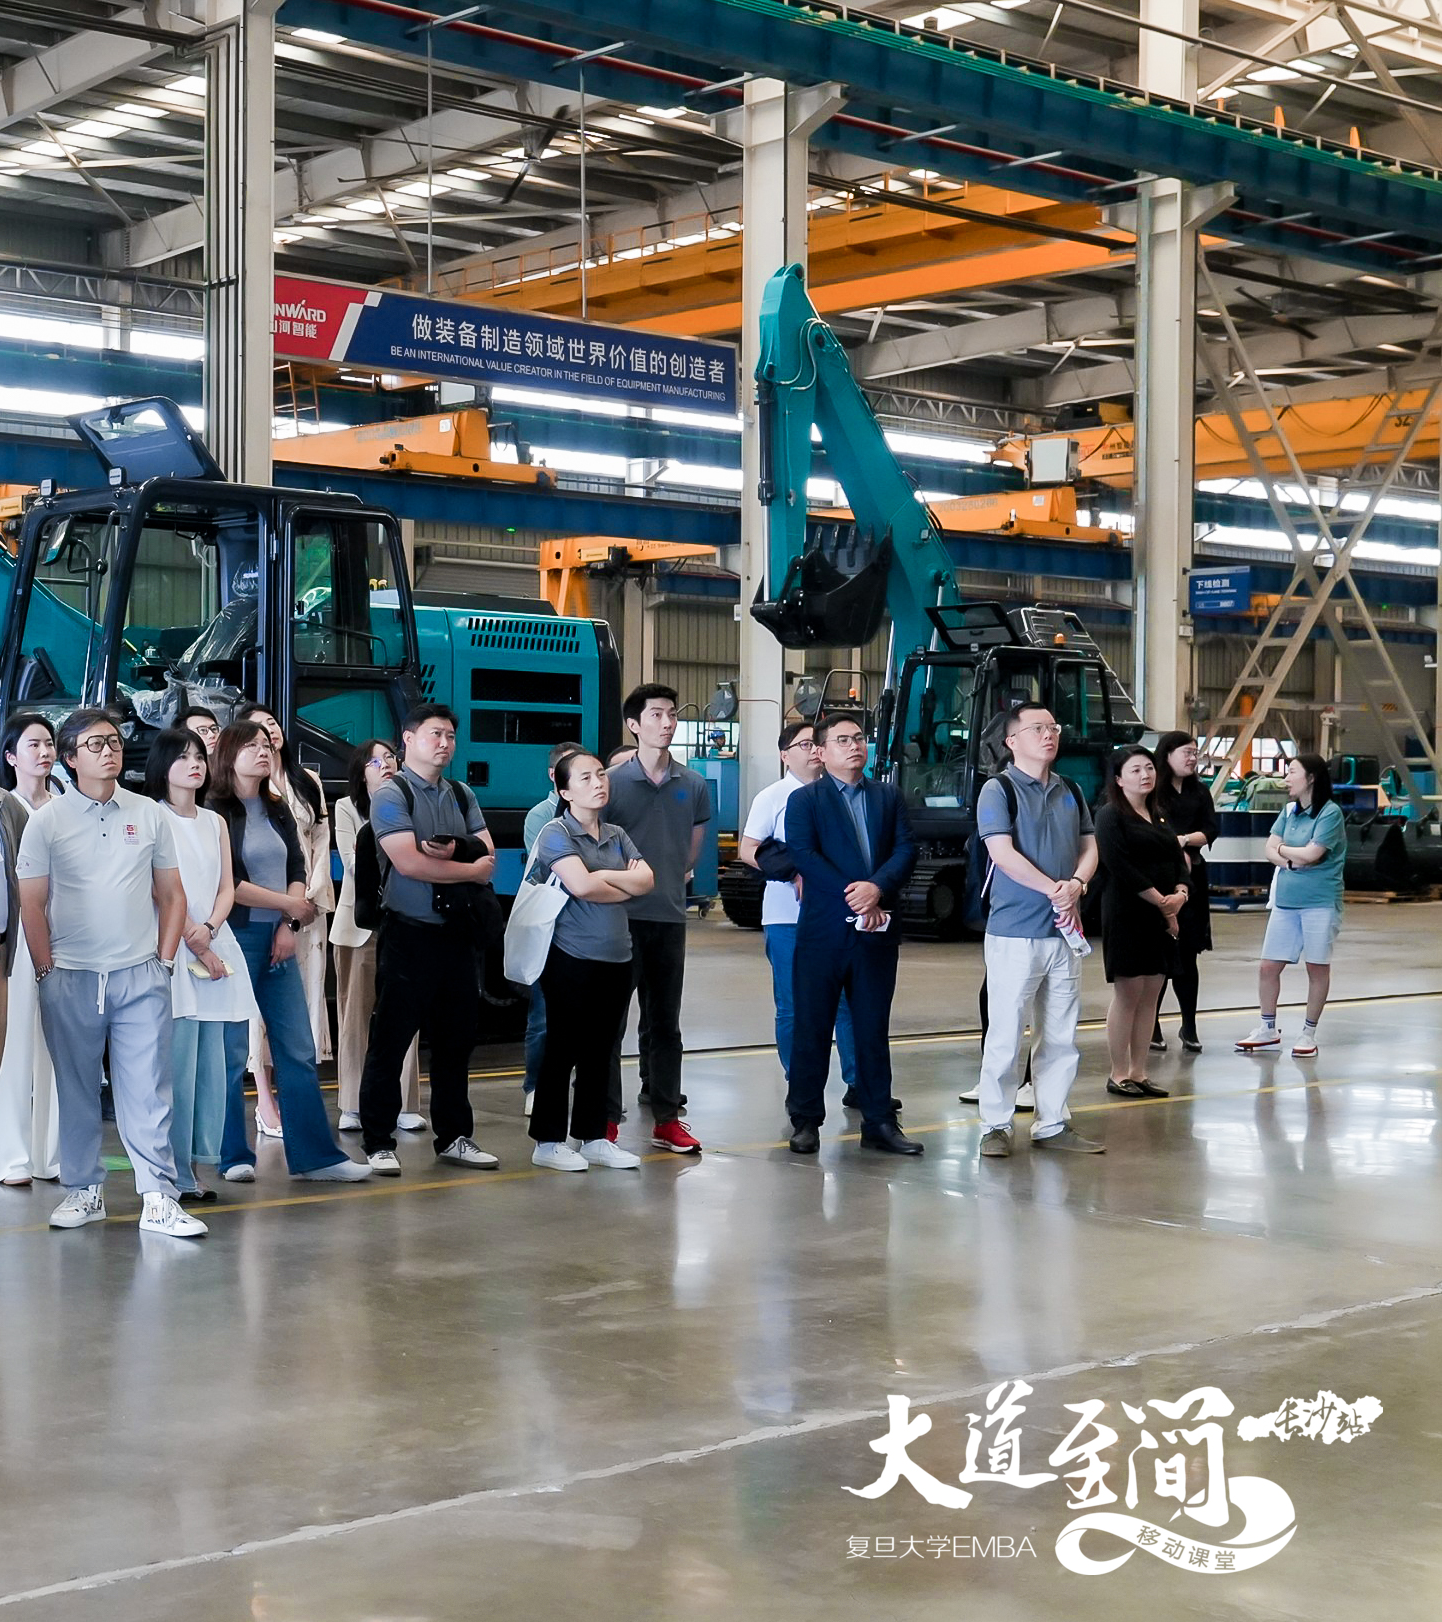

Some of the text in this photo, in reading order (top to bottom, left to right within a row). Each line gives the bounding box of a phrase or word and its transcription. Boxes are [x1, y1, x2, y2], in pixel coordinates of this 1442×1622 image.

[390, 345, 726, 401] BE AN INTERNATIONAL VALUE CREATOR IN THE FIELD OF EQUIPMENT MANUFACTURING
[411, 313, 725, 384] 做装备制造领域世界价值的创造者
